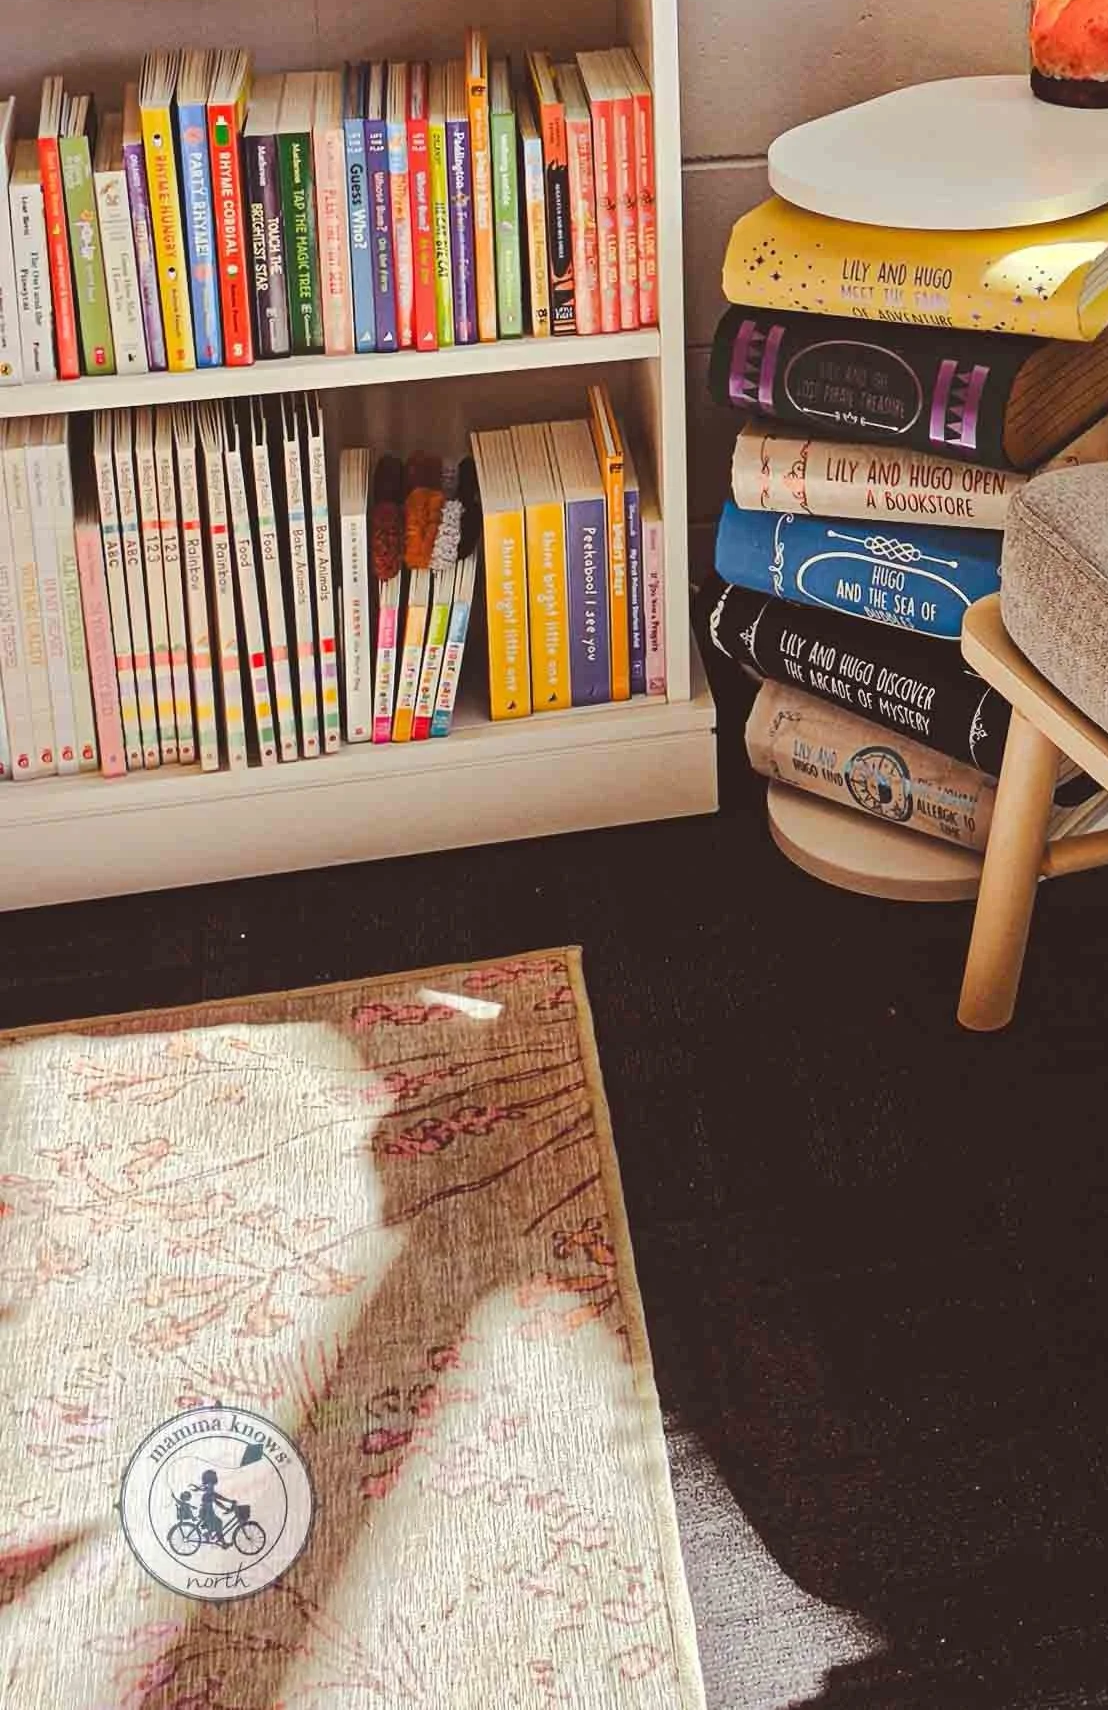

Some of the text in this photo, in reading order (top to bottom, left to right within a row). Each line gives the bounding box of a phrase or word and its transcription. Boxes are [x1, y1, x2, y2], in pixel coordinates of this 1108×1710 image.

[189, 152, 205, 194] PARTY
[218, 152, 239, 257] RHYME CORDIAL
[350, 164, 367, 249] Guess Who?
[251, 203, 268, 291] BRIGHTEST STAR
[269, 217, 283, 275] TOUCH THE
[293, 189, 311, 297] TAP THE MAGIC TREE
[842, 258, 953, 290] LILY AND HUGO
[826, 457, 1006, 495] LILY AND HUGO OPEN
[867, 490, 975, 517] A BOOKSTORE
[107, 541, 119, 567] ABC
[147, 535, 160, 563] 123
[187, 539, 202, 591] Rainbow
[264, 533, 275, 560] Food
[315, 524, 331, 601] Baby Animals
[543, 530, 556, 569] Shine
[582, 527, 597, 595] Peekaboo!
[537, 573, 558, 616] bright
[872, 565, 905, 592] HUGO
[836, 579, 937, 621] AND THE SEA OF
[585, 611, 596, 633] see
[582, 638, 597, 661] you
[780, 630, 935, 711] LILY AND HUGO DISCOVER
[547, 661, 558, 684] one
[784, 658, 930, 735] THE ARCADE OF MYSTERY
